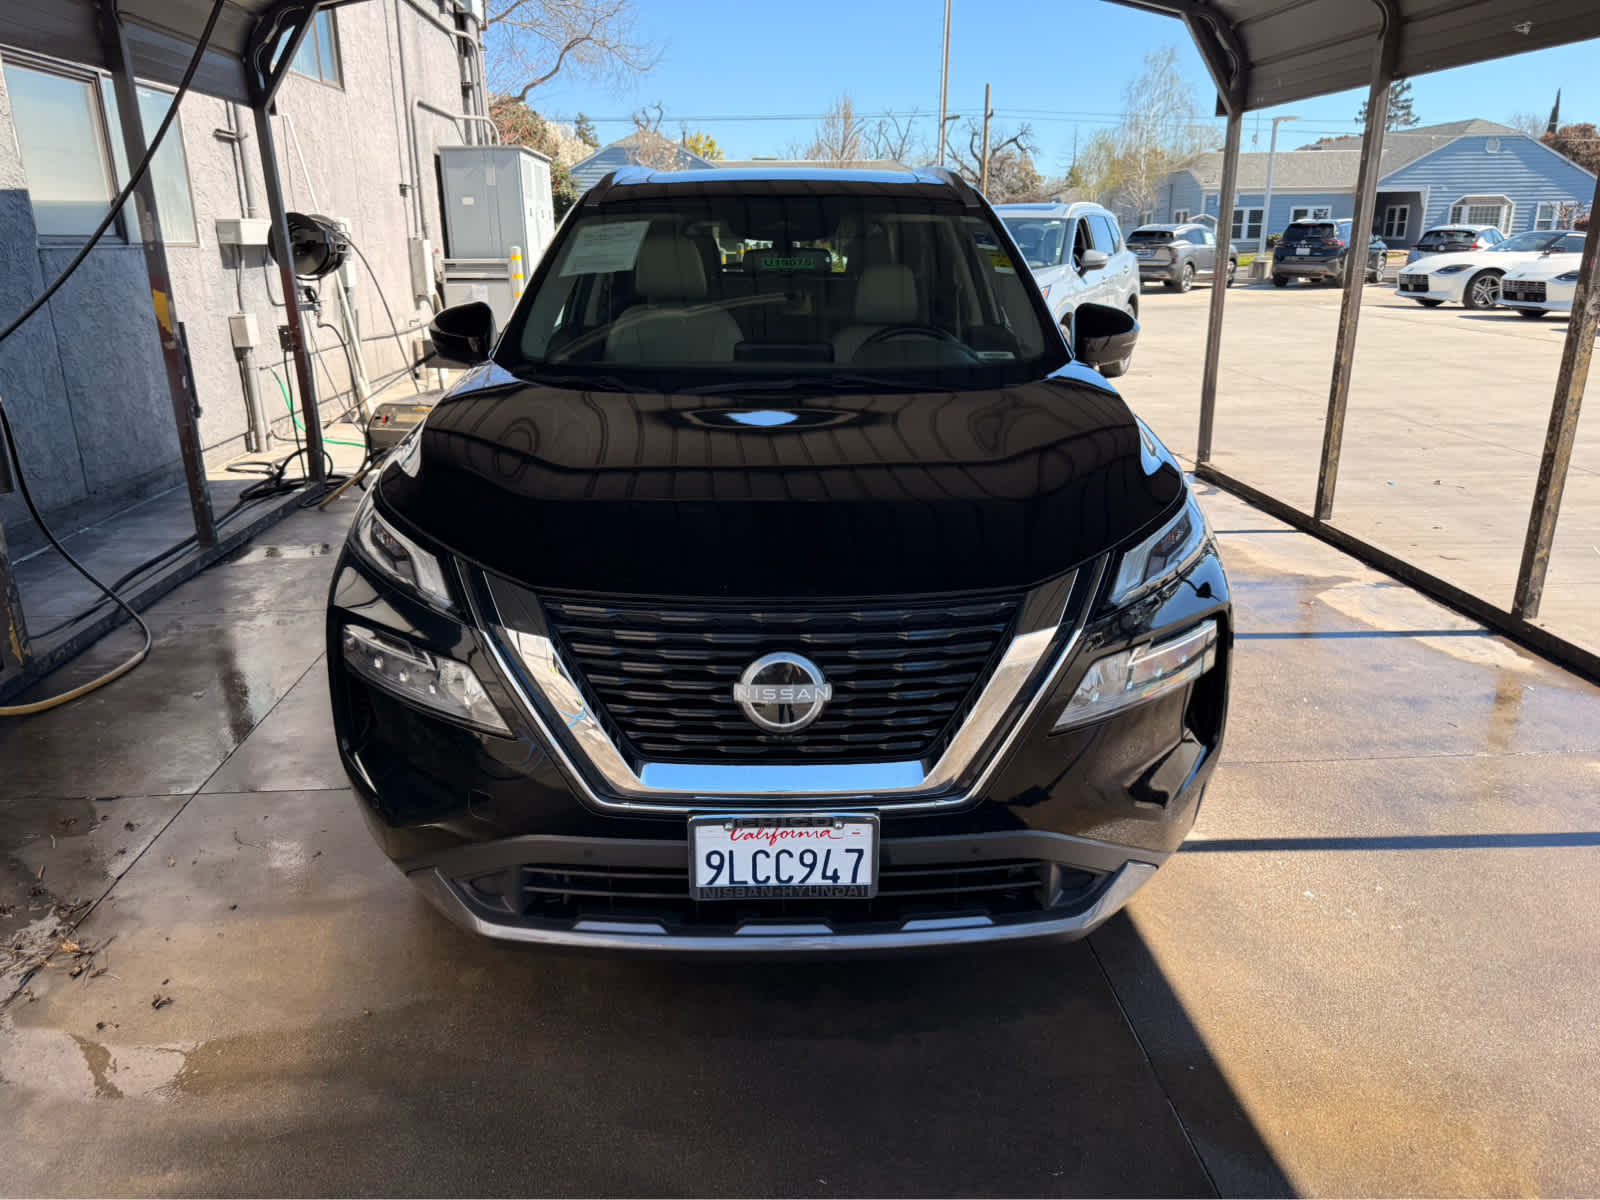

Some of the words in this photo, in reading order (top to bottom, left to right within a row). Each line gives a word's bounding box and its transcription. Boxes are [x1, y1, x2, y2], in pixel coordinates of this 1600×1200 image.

[736, 687, 829, 700] NISSAN
[730, 828, 843, 846] California
[705, 848, 865, 885] 9LCC947
